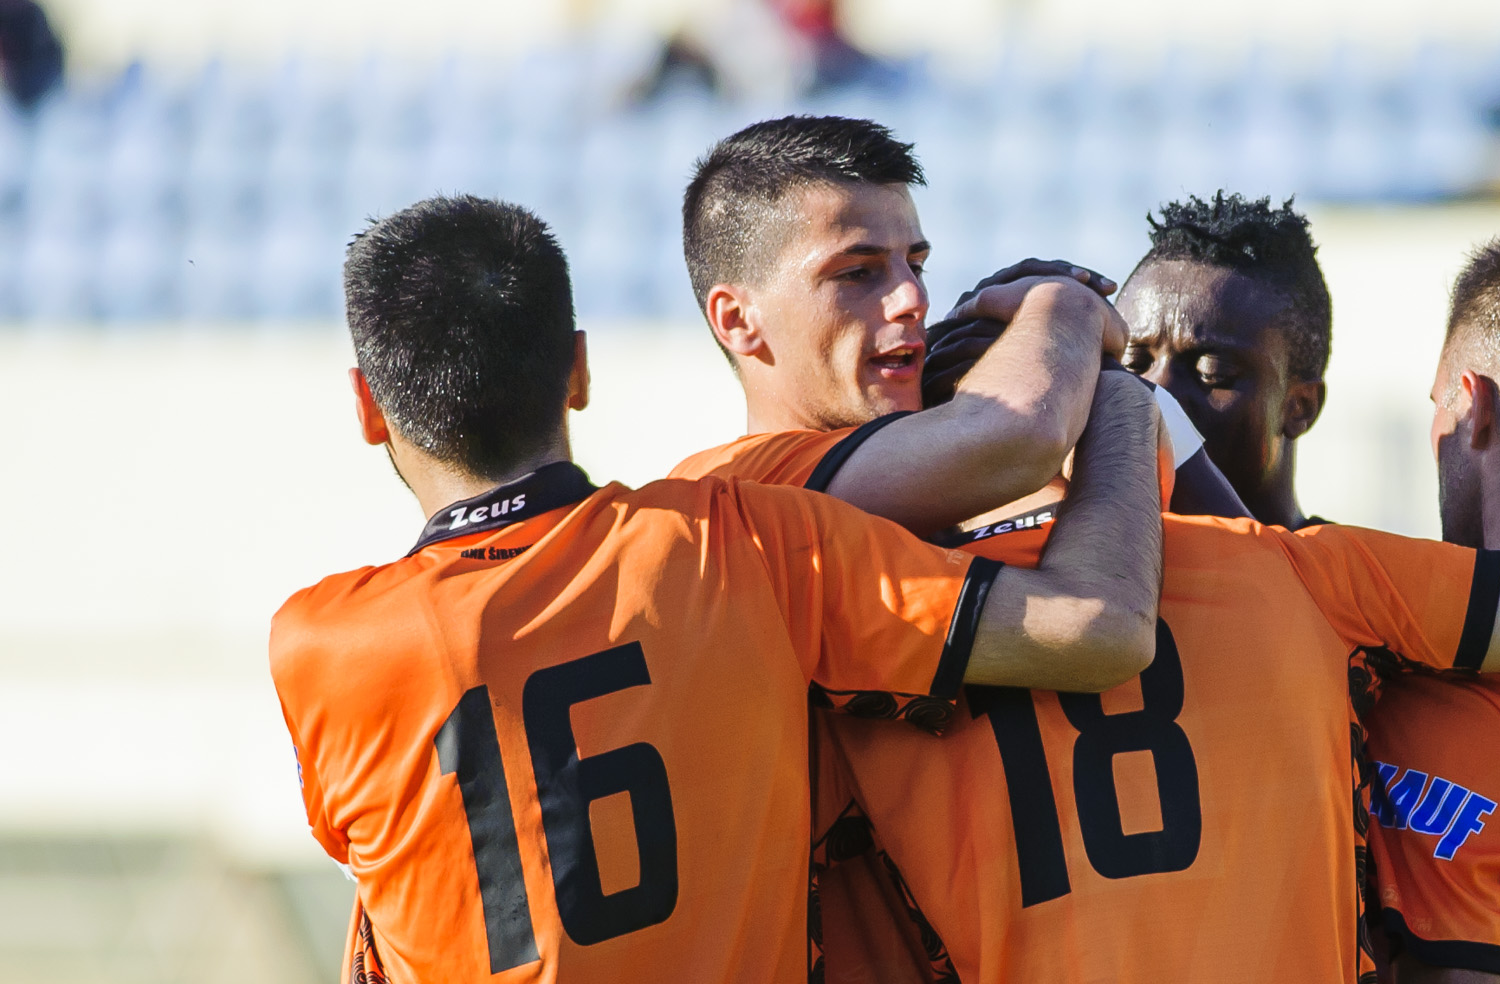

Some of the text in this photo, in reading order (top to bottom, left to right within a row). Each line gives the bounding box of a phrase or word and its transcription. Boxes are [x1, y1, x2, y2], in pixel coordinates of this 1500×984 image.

[448, 493, 526, 531] Zeus
[972, 511, 1053, 540] Zeus
[434, 640, 679, 975] 16
[964, 615, 1202, 909] 18
[1370, 760, 1498, 861] NAUF
